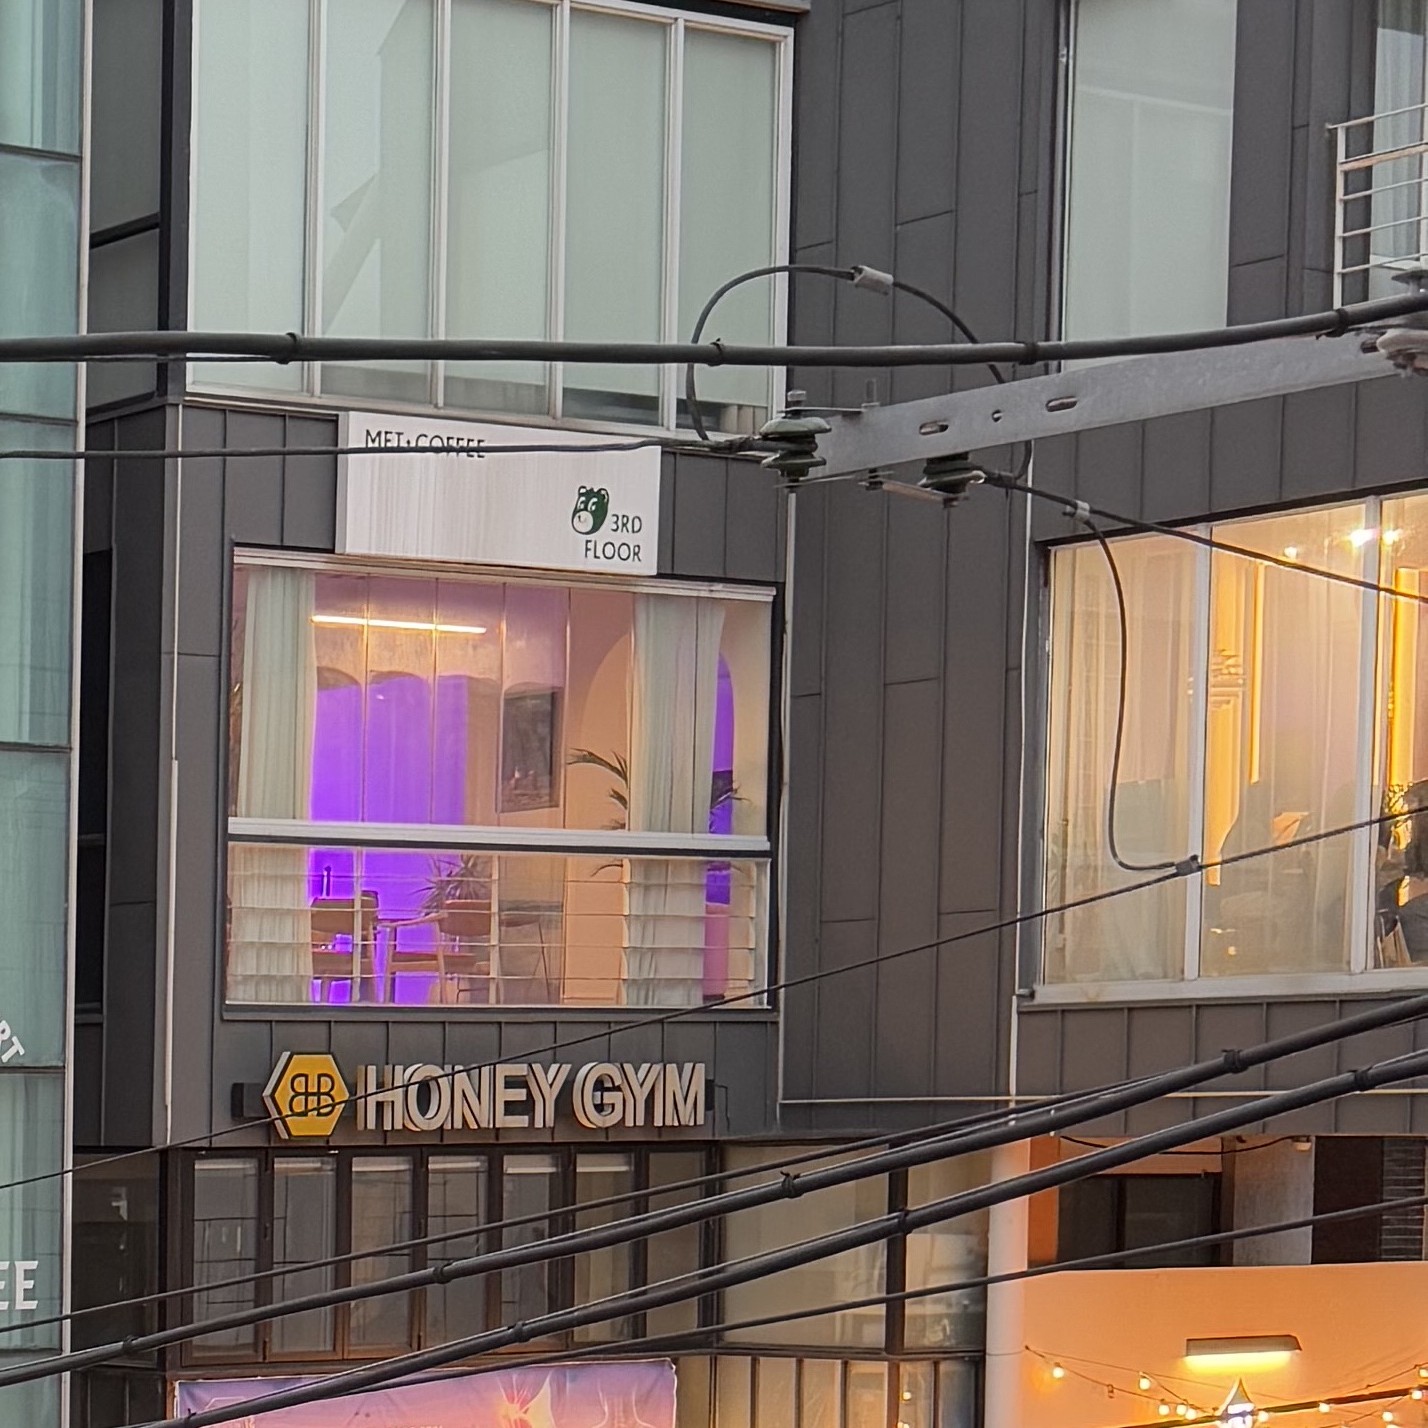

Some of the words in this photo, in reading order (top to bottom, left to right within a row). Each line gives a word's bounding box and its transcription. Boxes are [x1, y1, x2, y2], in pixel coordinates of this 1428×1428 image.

[610, 513, 642, 534] 3RD
[584, 540, 642, 562] FLOOR
[357, 1062, 571, 1131] HONEY
[573, 1062, 706, 1129] GYM
